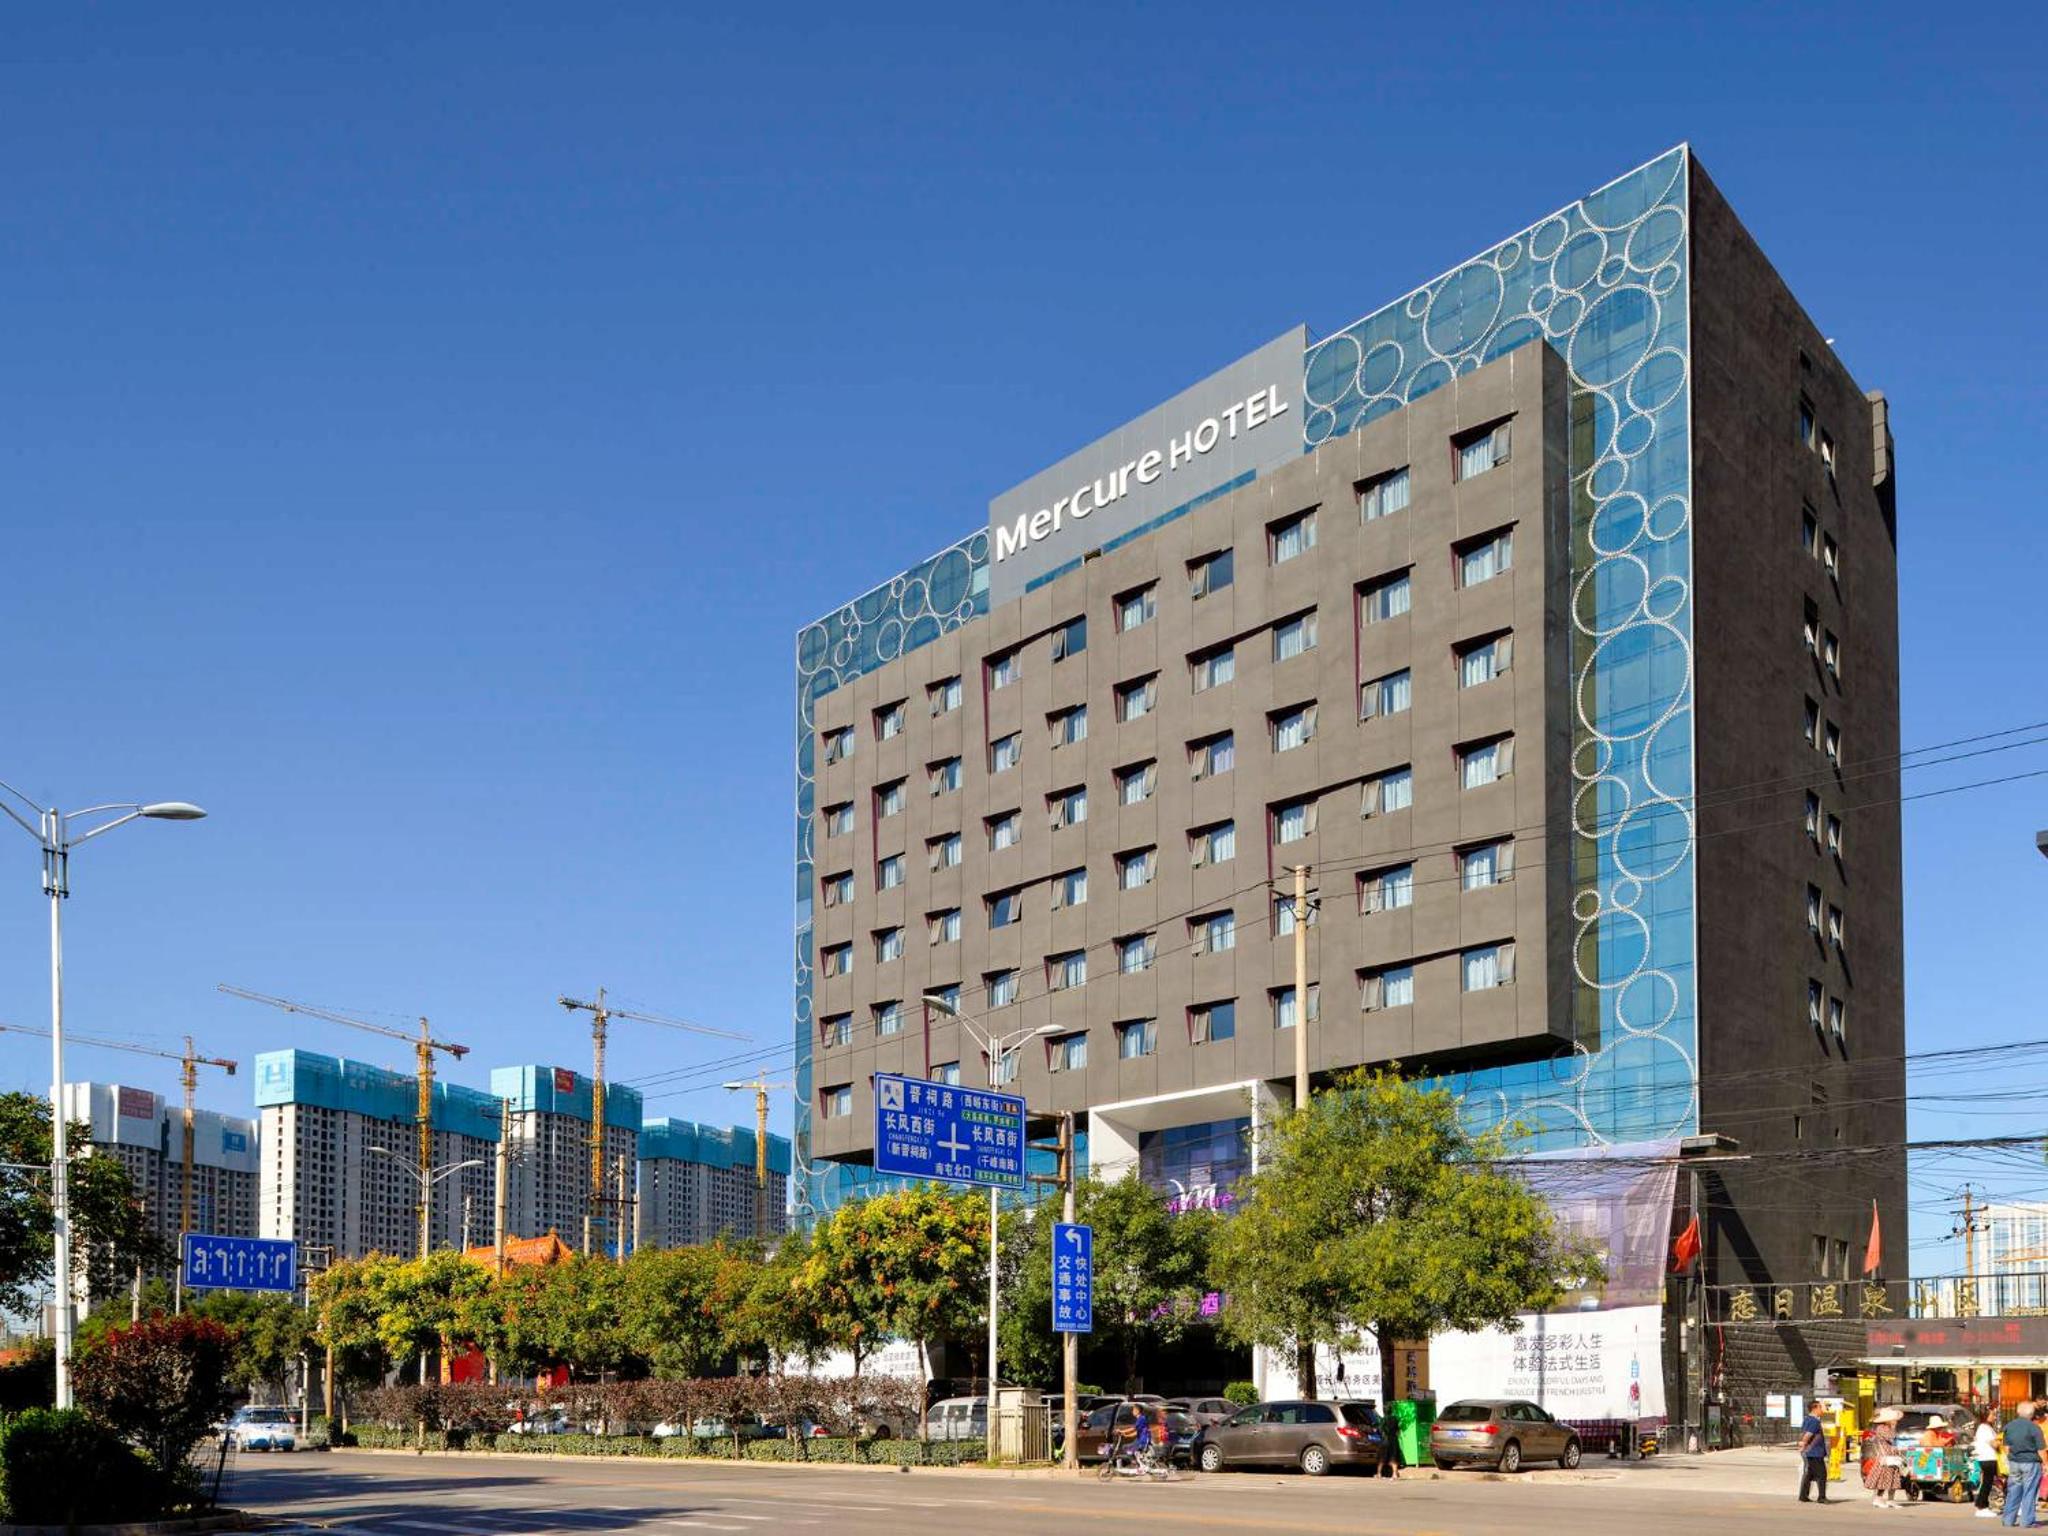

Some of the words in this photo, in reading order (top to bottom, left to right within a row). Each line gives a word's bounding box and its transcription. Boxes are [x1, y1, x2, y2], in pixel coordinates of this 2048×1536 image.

[996, 450, 1162, 562] Mercure
[1170, 384, 1289, 470] HOTEL
[885, 1112, 935, 1136] 长风西街
[972, 1124, 1017, 1148] 长风西街
[1058, 1255, 1072, 1319] 交通事故
[1075, 1256, 1088, 1320] 快处中心
[1513, 1333, 1602, 1351] 激发多彩人生
[1513, 1354, 1601, 1372] 体验法式生活
